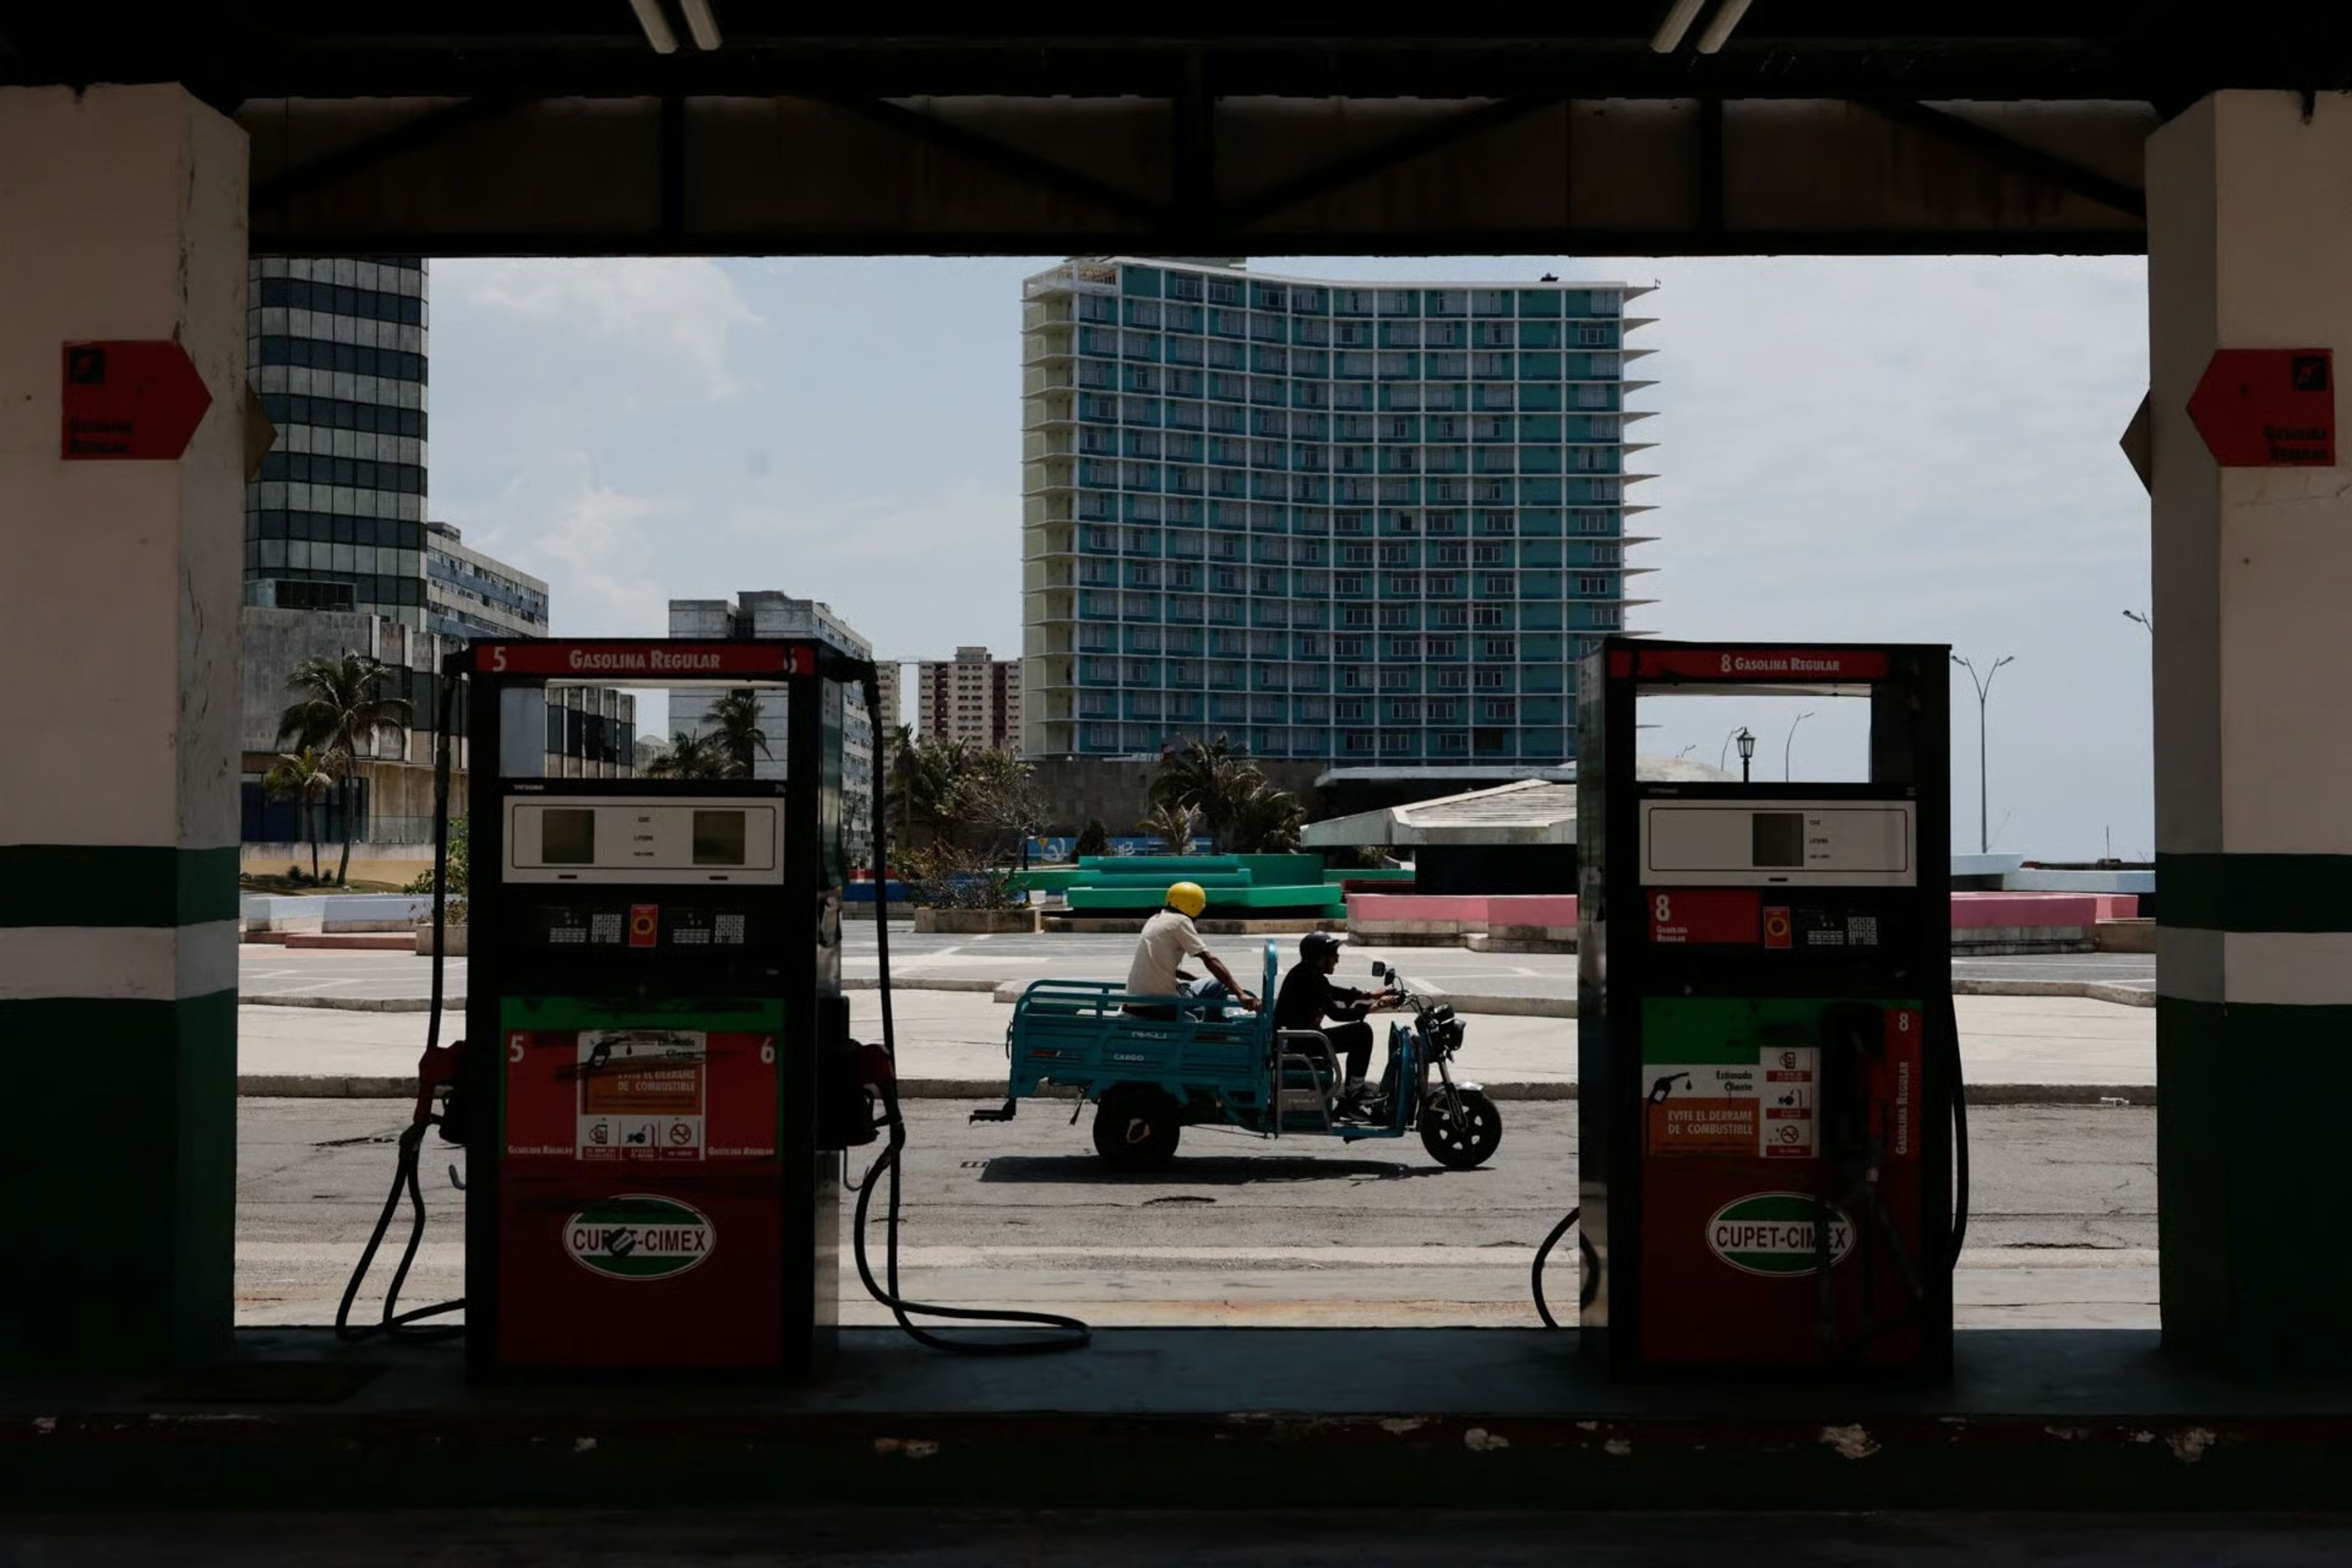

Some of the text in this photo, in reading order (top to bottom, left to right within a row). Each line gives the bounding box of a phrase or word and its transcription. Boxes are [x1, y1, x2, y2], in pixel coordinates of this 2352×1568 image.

[492, 647, 507, 672] 5
[1721, 653, 1732, 673] 8
[1656, 892, 1671, 922] 8
[1900, 1012, 1909, 1031] 8
[510, 1034, 524, 1063] 5
[760, 1035, 775, 1064] 6
[1114, 1053, 1145, 1061] CARGO
[1716, 1070, 1752, 1080] Estimado
[617, 1080, 696, 1091] DE COMBUSTIBLE
[1724, 1082, 1752, 1091] Cliente
[1668, 1110, 1754, 1122] EVITE EL DERRAME
[1668, 1123, 1754, 1136] DE COMBUSTIBLE
